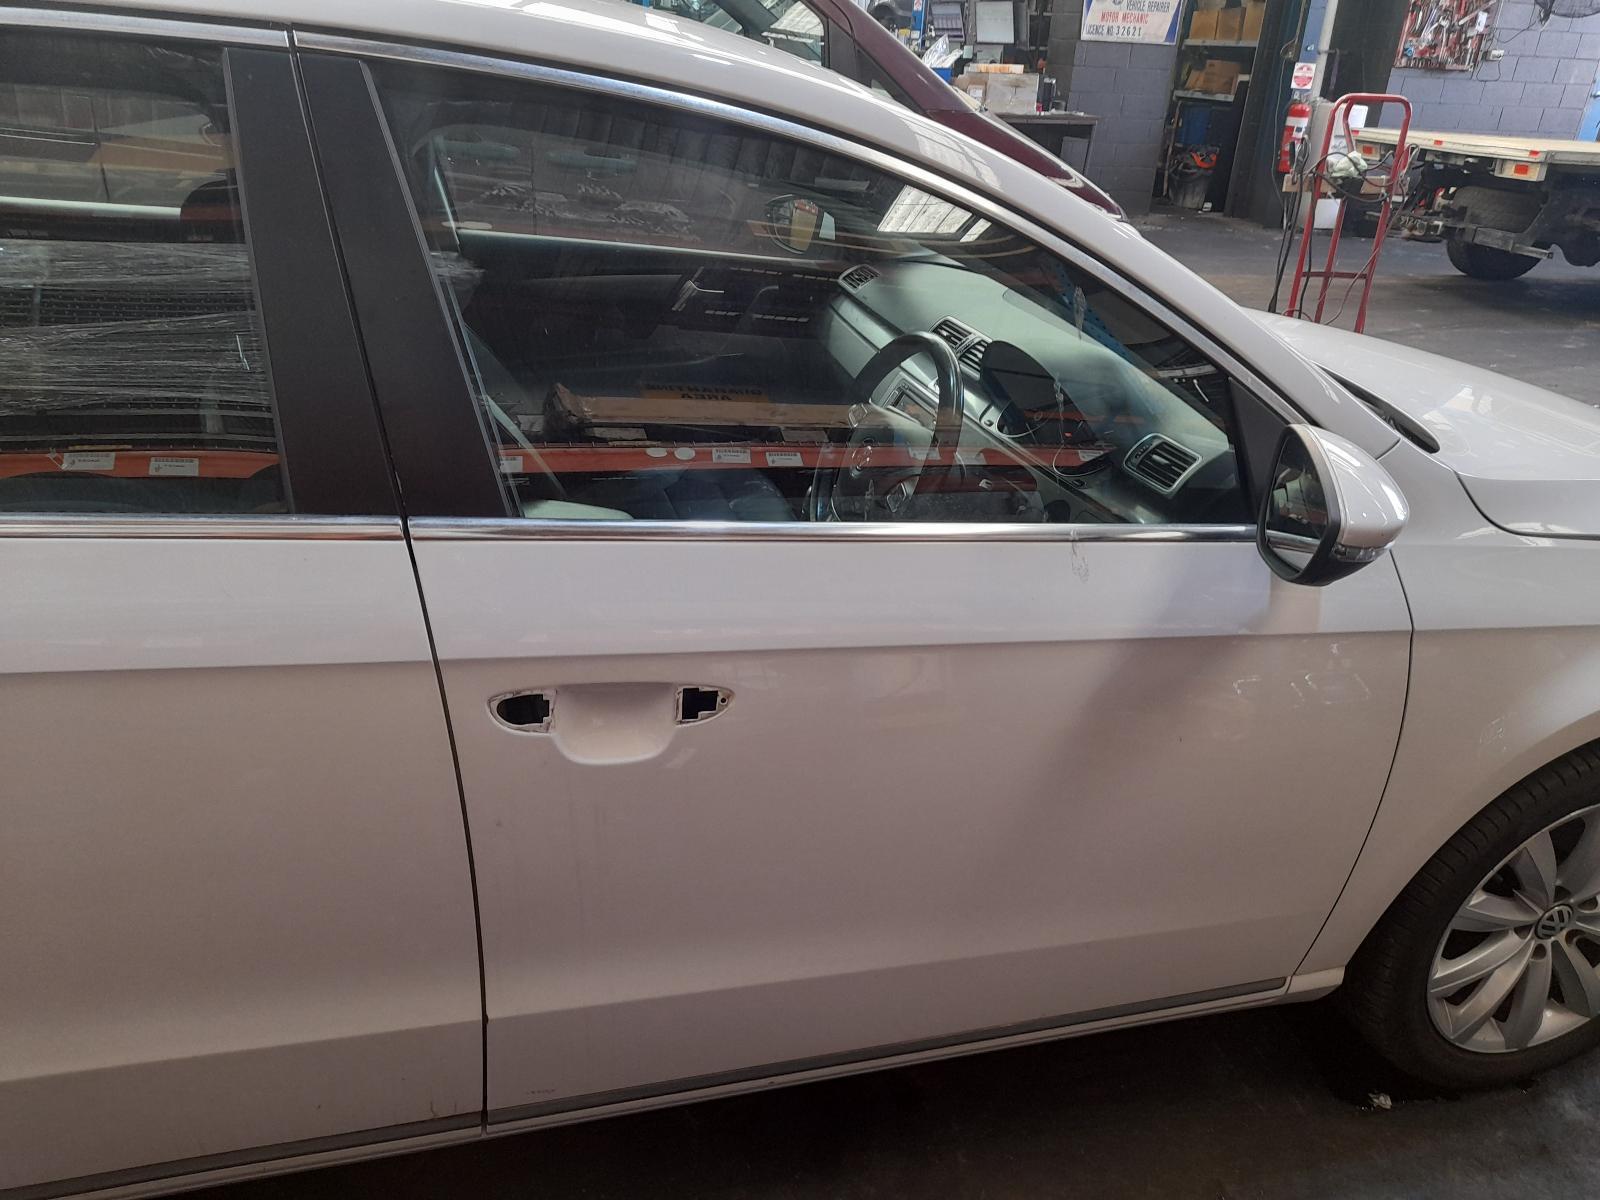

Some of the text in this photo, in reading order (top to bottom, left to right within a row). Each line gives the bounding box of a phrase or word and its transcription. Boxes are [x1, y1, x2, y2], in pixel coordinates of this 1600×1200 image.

[1126, 0, 1170, 13] VEHICLE REPAIRER
[1101, 11, 1149, 25] MOTOR MECHANIC
